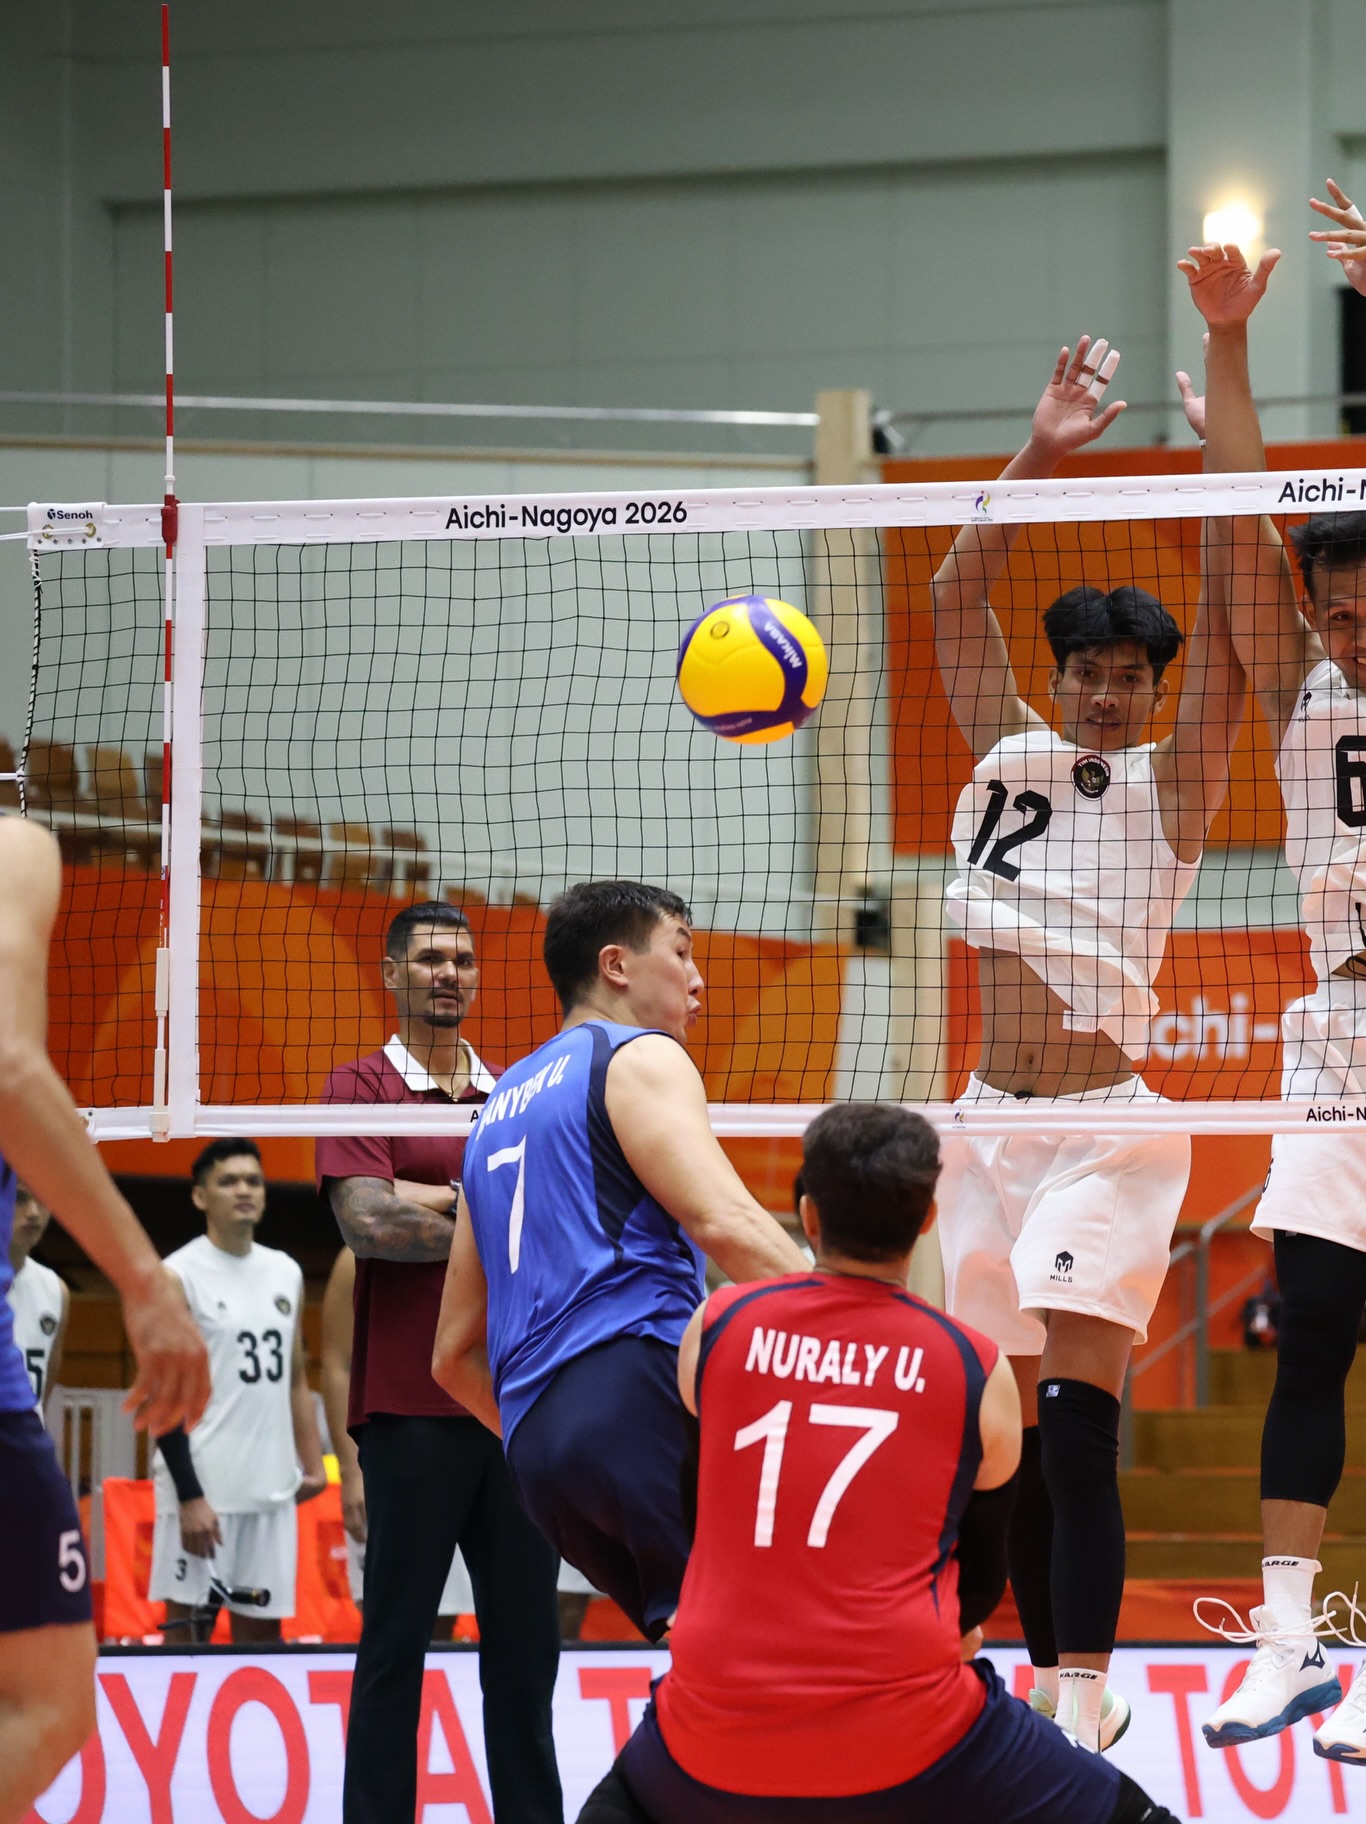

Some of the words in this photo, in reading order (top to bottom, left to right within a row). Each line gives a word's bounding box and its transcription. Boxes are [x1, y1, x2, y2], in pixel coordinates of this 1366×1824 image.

[56, 510, 93, 520] Senoh
[445, 503, 617, 533] Aichi-Nagoya
[625, 501, 688, 525] 2026
[966, 779, 1053, 882] 12
[487, 1134, 527, 1275] 7
[1049, 1274, 1073, 1284] MILLS
[236, 1329, 284, 1384] 33
[744, 1326, 890, 1387] NURALY
[894, 1345, 926, 1394] U.
[733, 1399, 900, 1548] 17
[58, 1529, 87, 1593] 5
